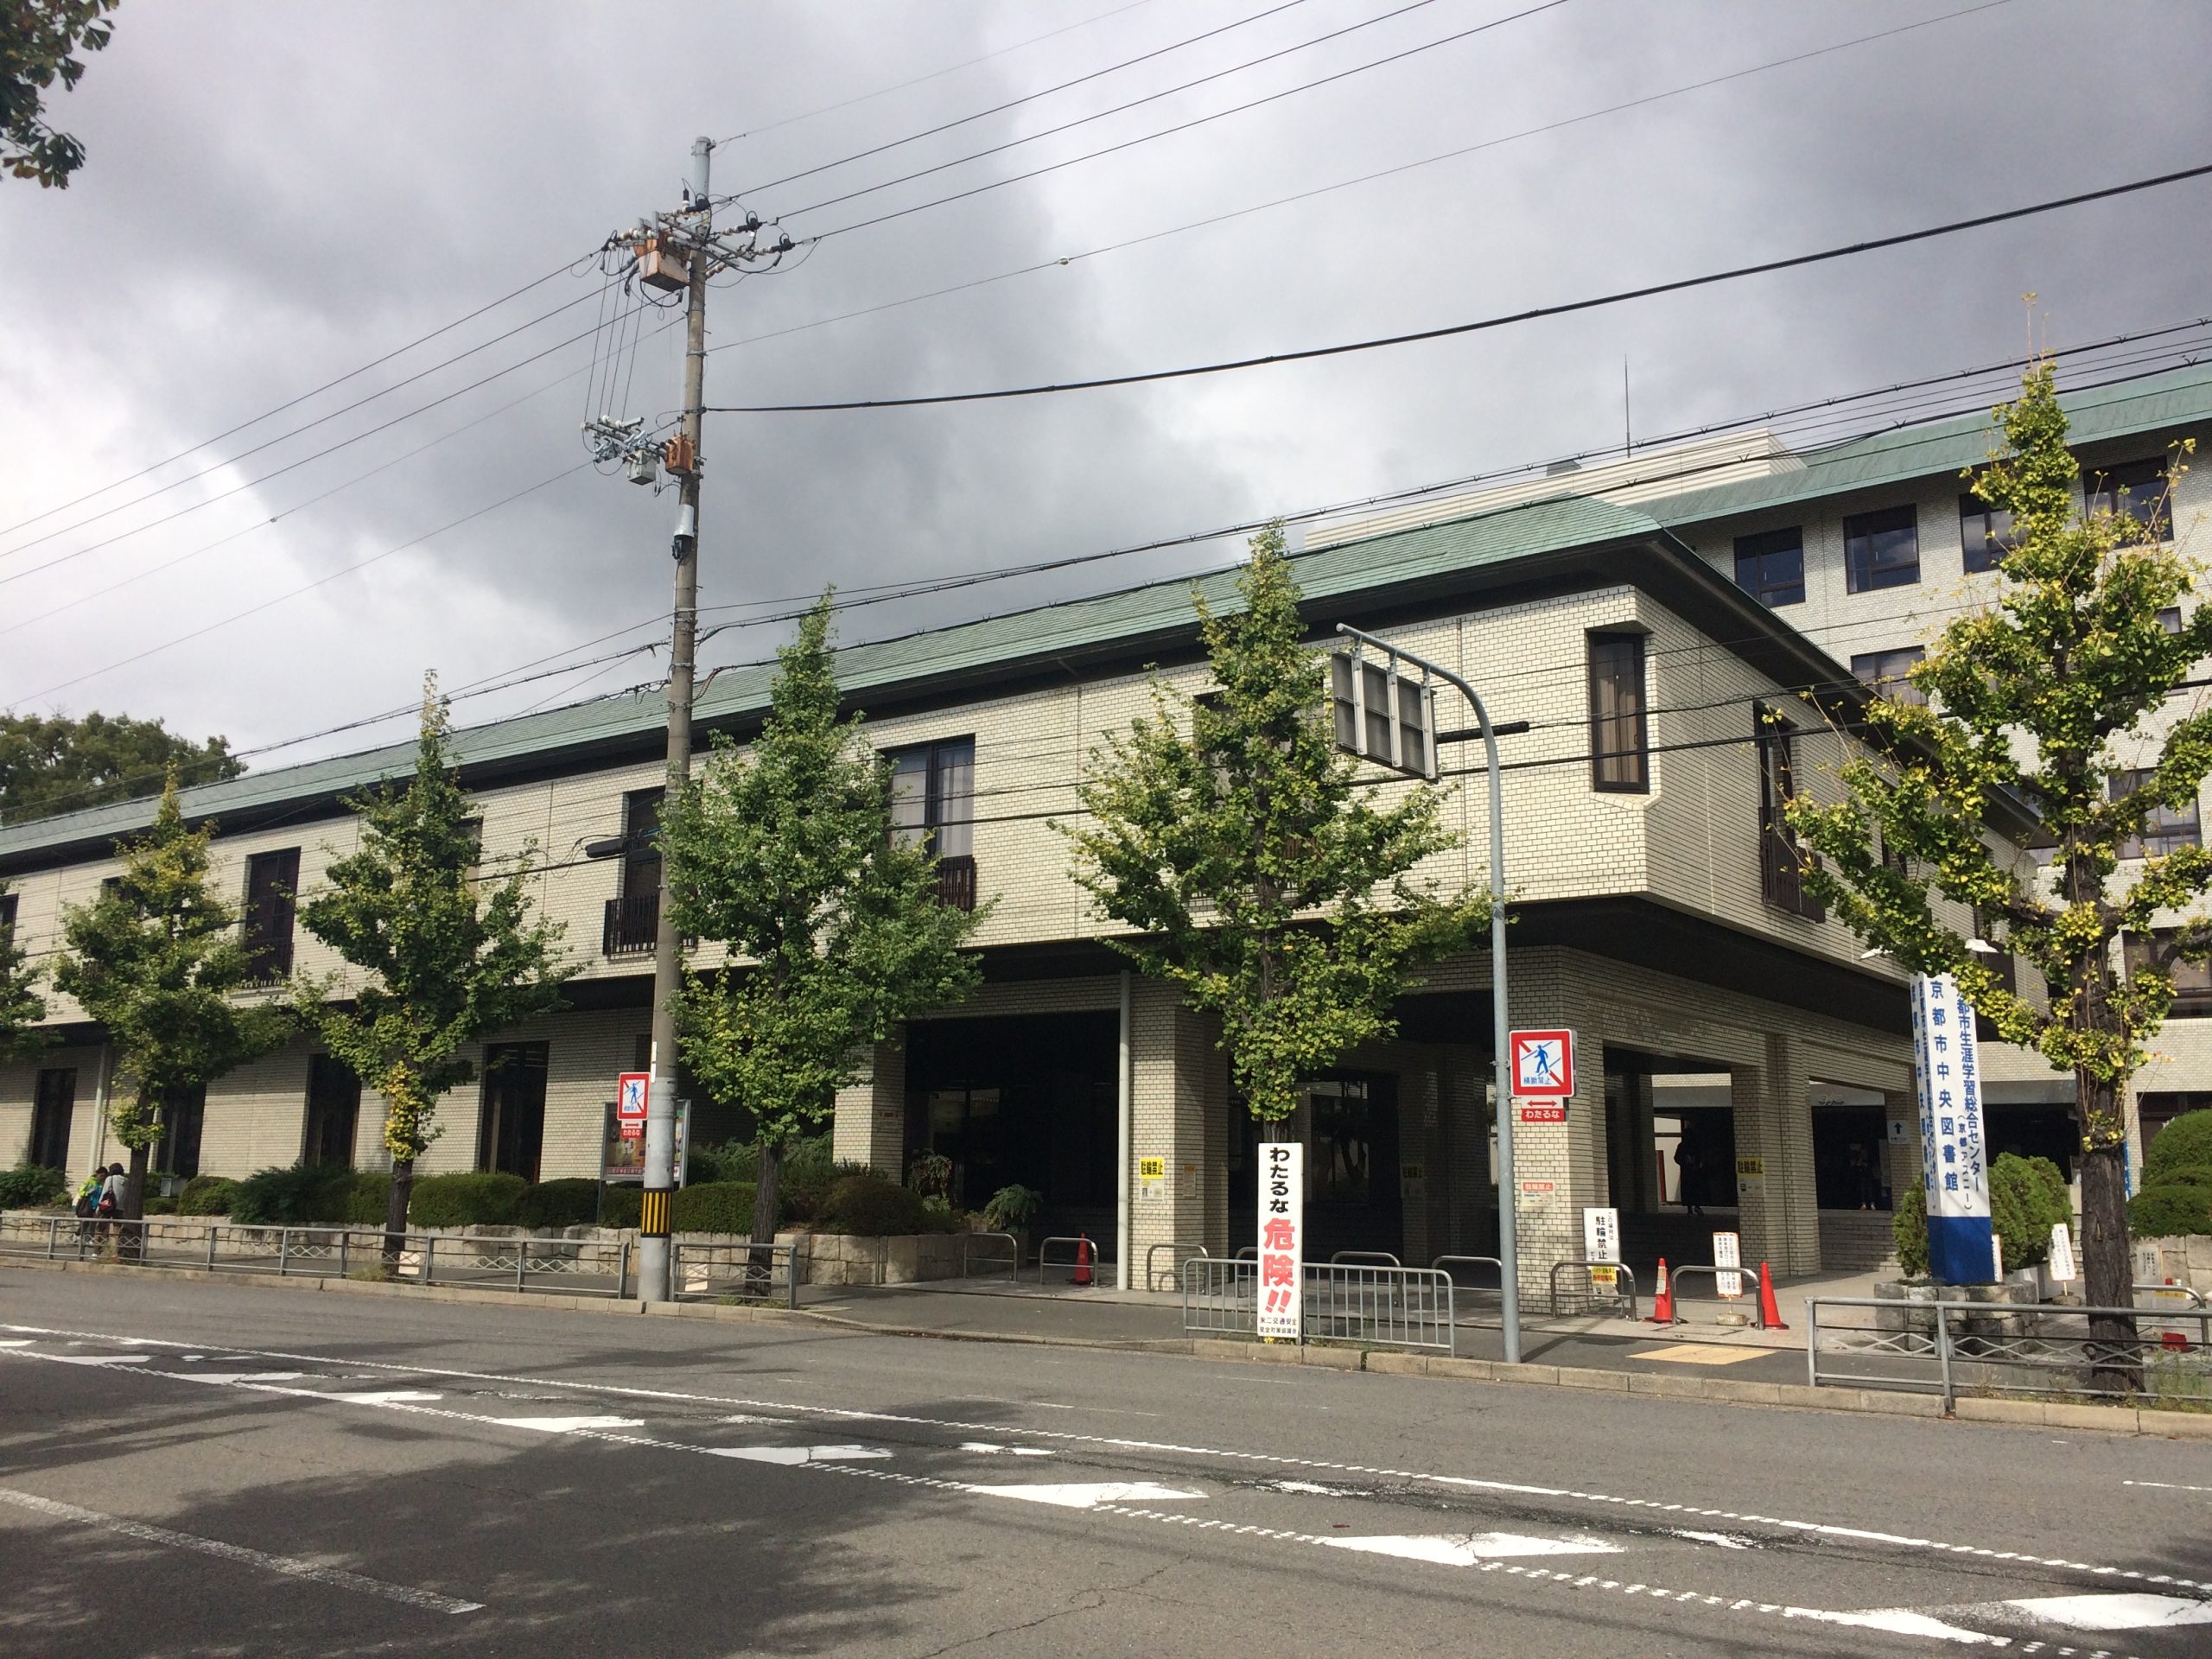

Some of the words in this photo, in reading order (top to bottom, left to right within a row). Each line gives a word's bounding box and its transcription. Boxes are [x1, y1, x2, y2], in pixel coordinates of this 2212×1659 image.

[1523, 1077, 1552, 1085] 横断禁止
[1930, 980, 1959, 1192] 京都市中央図書館
[1956, 993, 1980, 1192] 都市生涯学習総合センター
[1526, 1109, 1560, 1119] わたるな
[1268, 1147, 1290, 1213] わたるな
[1595, 1216, 1608, 1260] 駐輪禁止
